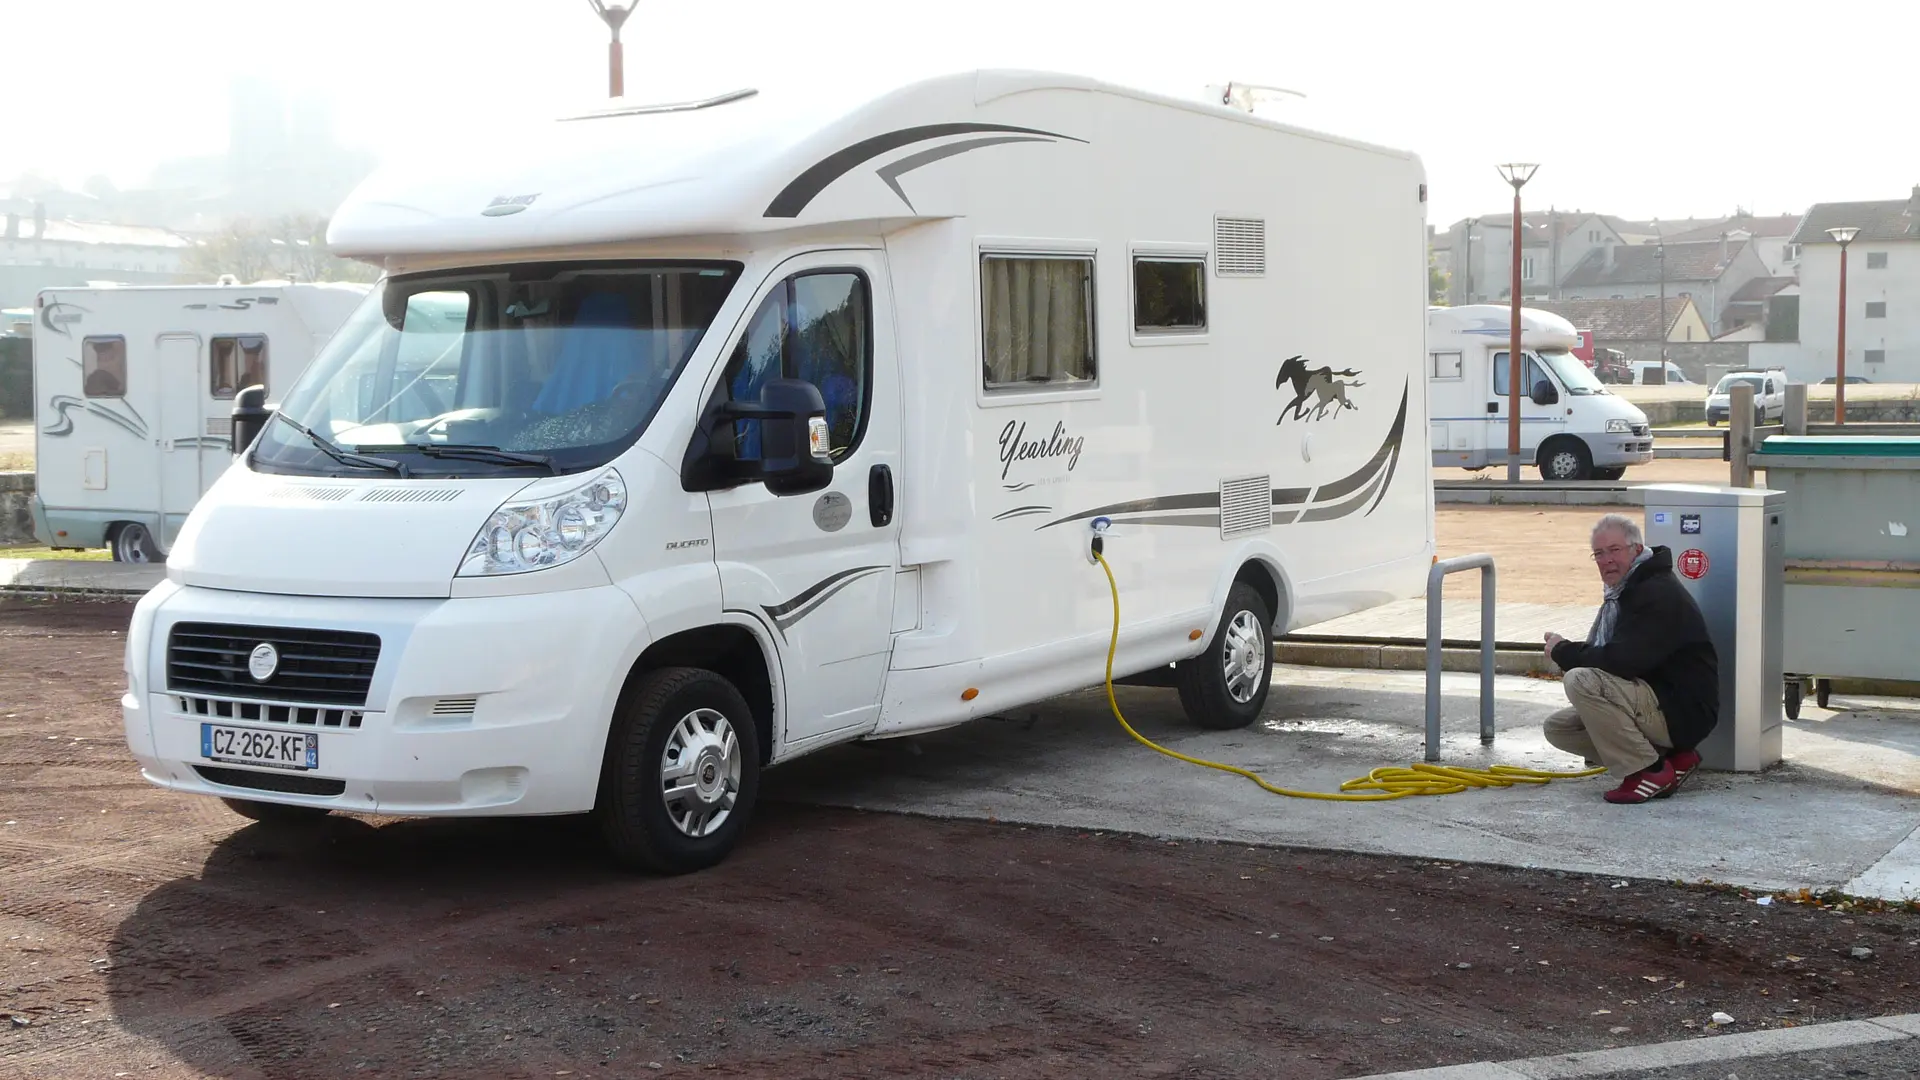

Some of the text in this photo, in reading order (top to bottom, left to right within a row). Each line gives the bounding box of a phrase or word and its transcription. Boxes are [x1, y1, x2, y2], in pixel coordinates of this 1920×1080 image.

[998, 420, 1084, 480] Yearling
[665, 538, 709, 550] DUCATO
[306, 752, 316, 765] 42
